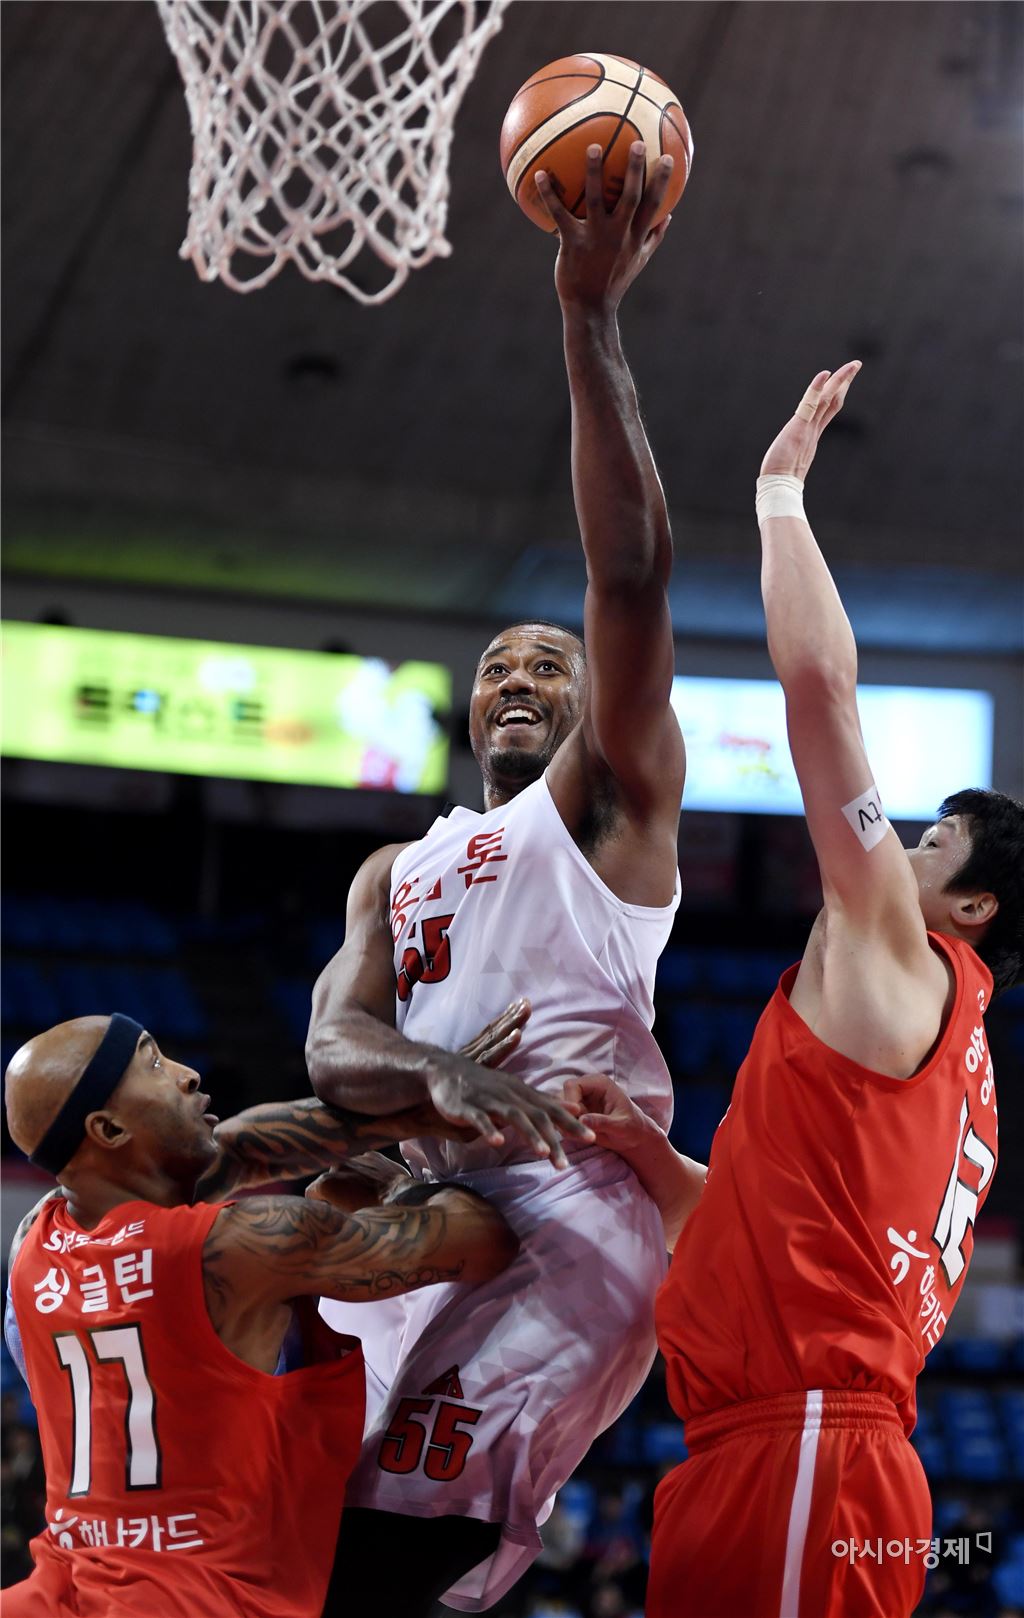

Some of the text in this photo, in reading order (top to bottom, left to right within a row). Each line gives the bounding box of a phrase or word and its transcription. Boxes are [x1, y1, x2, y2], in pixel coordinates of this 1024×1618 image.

[33, 1248, 154, 1314] 싱글턴
[51, 1321, 162, 1498] 17
[377, 1397, 483, 1482] 55
[78, 1513, 204, 1553] 하나카드
